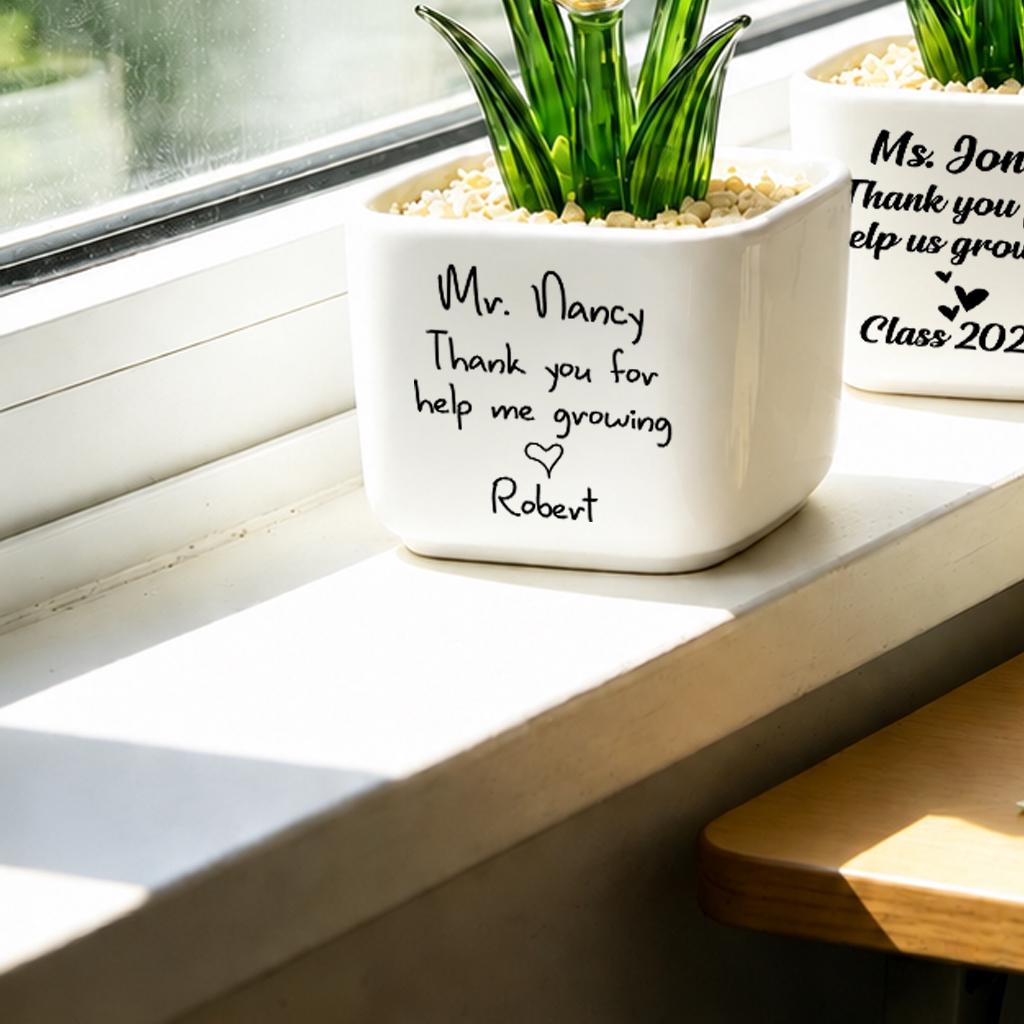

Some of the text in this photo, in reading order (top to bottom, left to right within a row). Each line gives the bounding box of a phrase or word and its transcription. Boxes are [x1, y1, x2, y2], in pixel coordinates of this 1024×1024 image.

[870, 129, 935, 169] Ms.
[850, 178, 949, 214] Thank
[952, 195, 1021, 225] you
[848, 221, 903, 261] elp
[905, 234, 949, 254] us
[437, 263, 645, 346] Mr. Nancy
[859, 315, 952, 348] Class
[425, 329, 659, 393] Thank you for
[413, 378, 673, 448] help me growing
[491, 476, 599, 523] Robert
